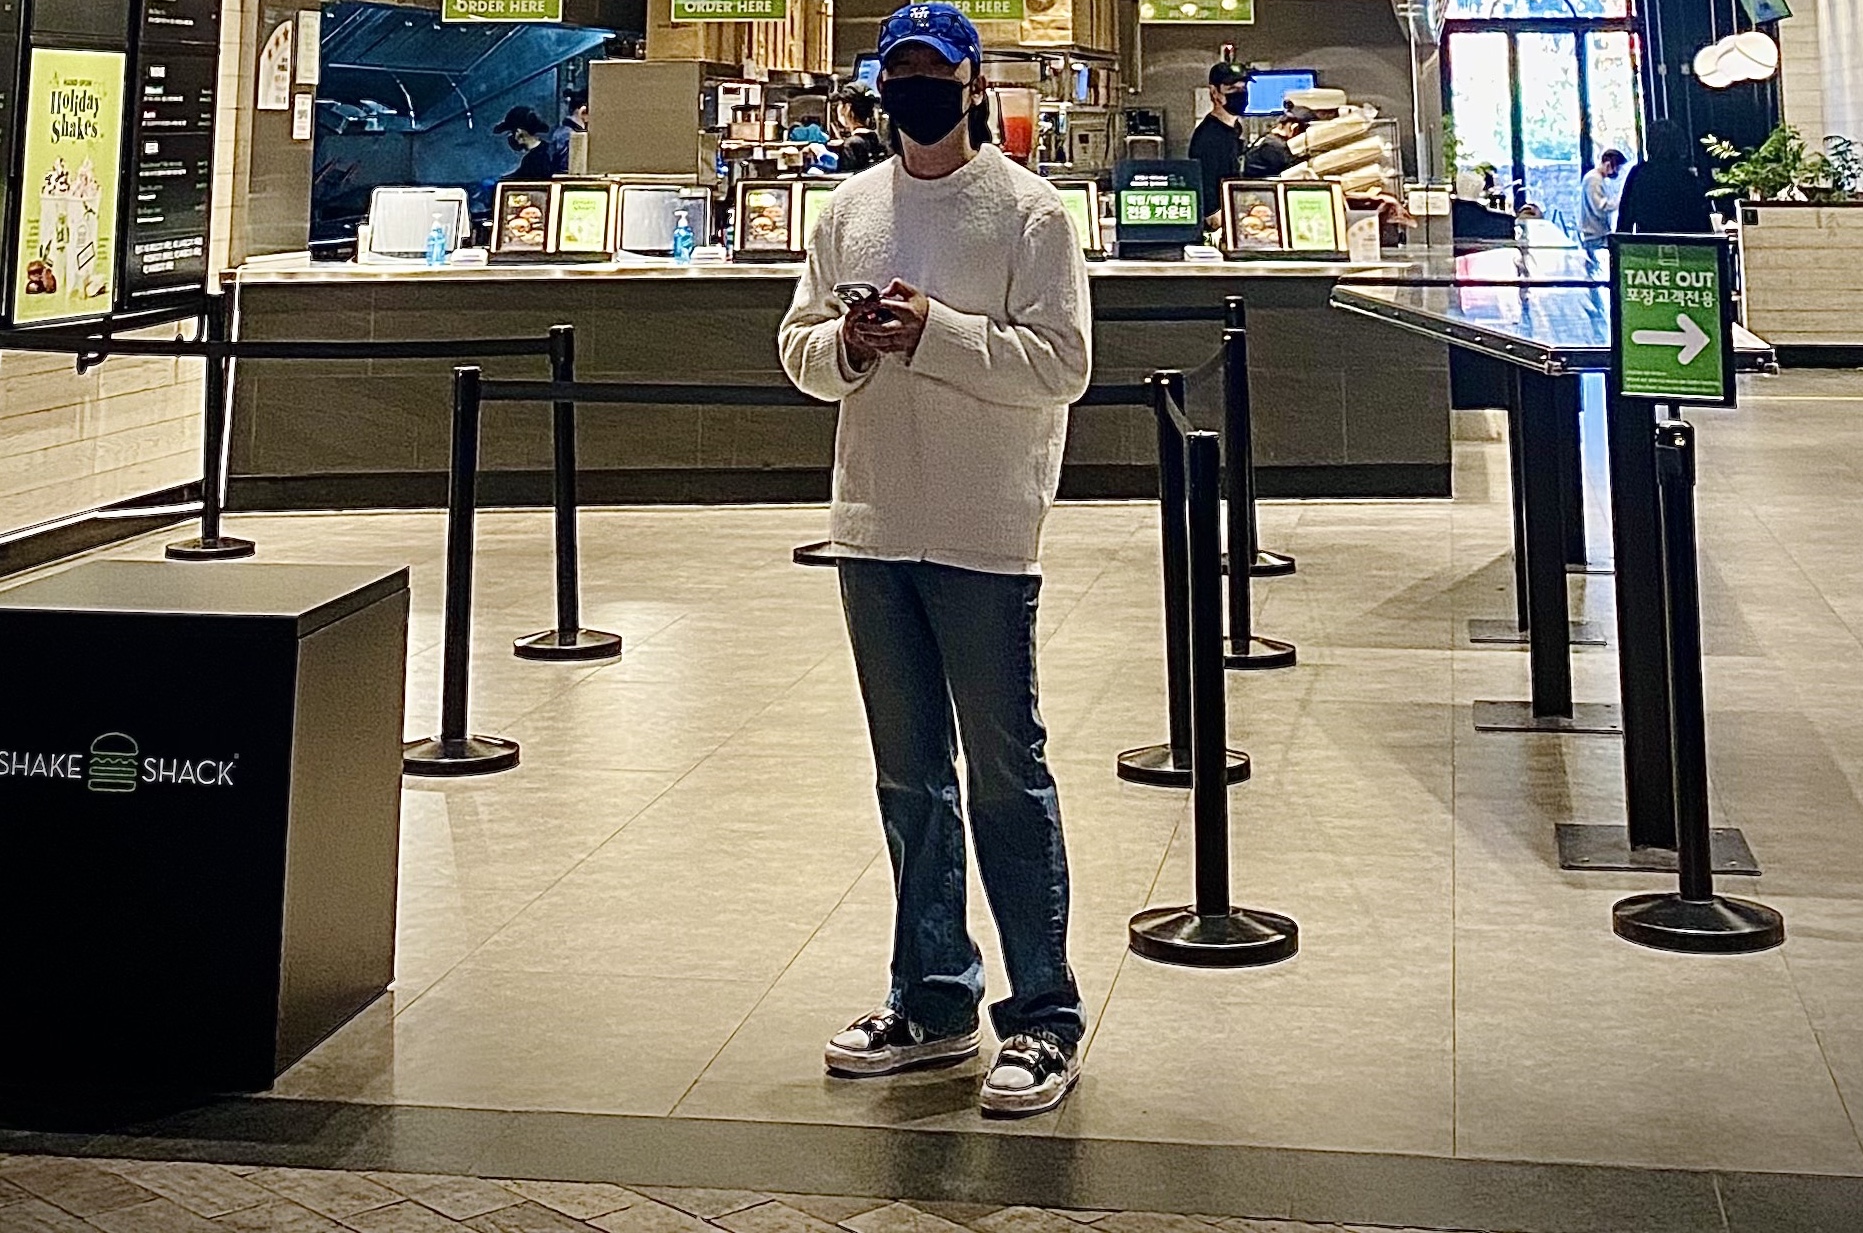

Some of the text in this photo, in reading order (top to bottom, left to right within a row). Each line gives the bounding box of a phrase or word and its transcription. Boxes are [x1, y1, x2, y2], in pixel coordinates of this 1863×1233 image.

[456, 0, 546, 13] ORDER HERE
[684, 0, 773, 14] ORDER HERE
[974, 0, 1011, 14] HERE
[50, 88, 100, 119] Holiday
[50, 113, 99, 145] Shakes
[1624, 269, 1715, 288] TAKE OUT
[1625, 288, 1716, 308] 포장고객전용
[0, 751, 234, 786] SHAKE SHACK
